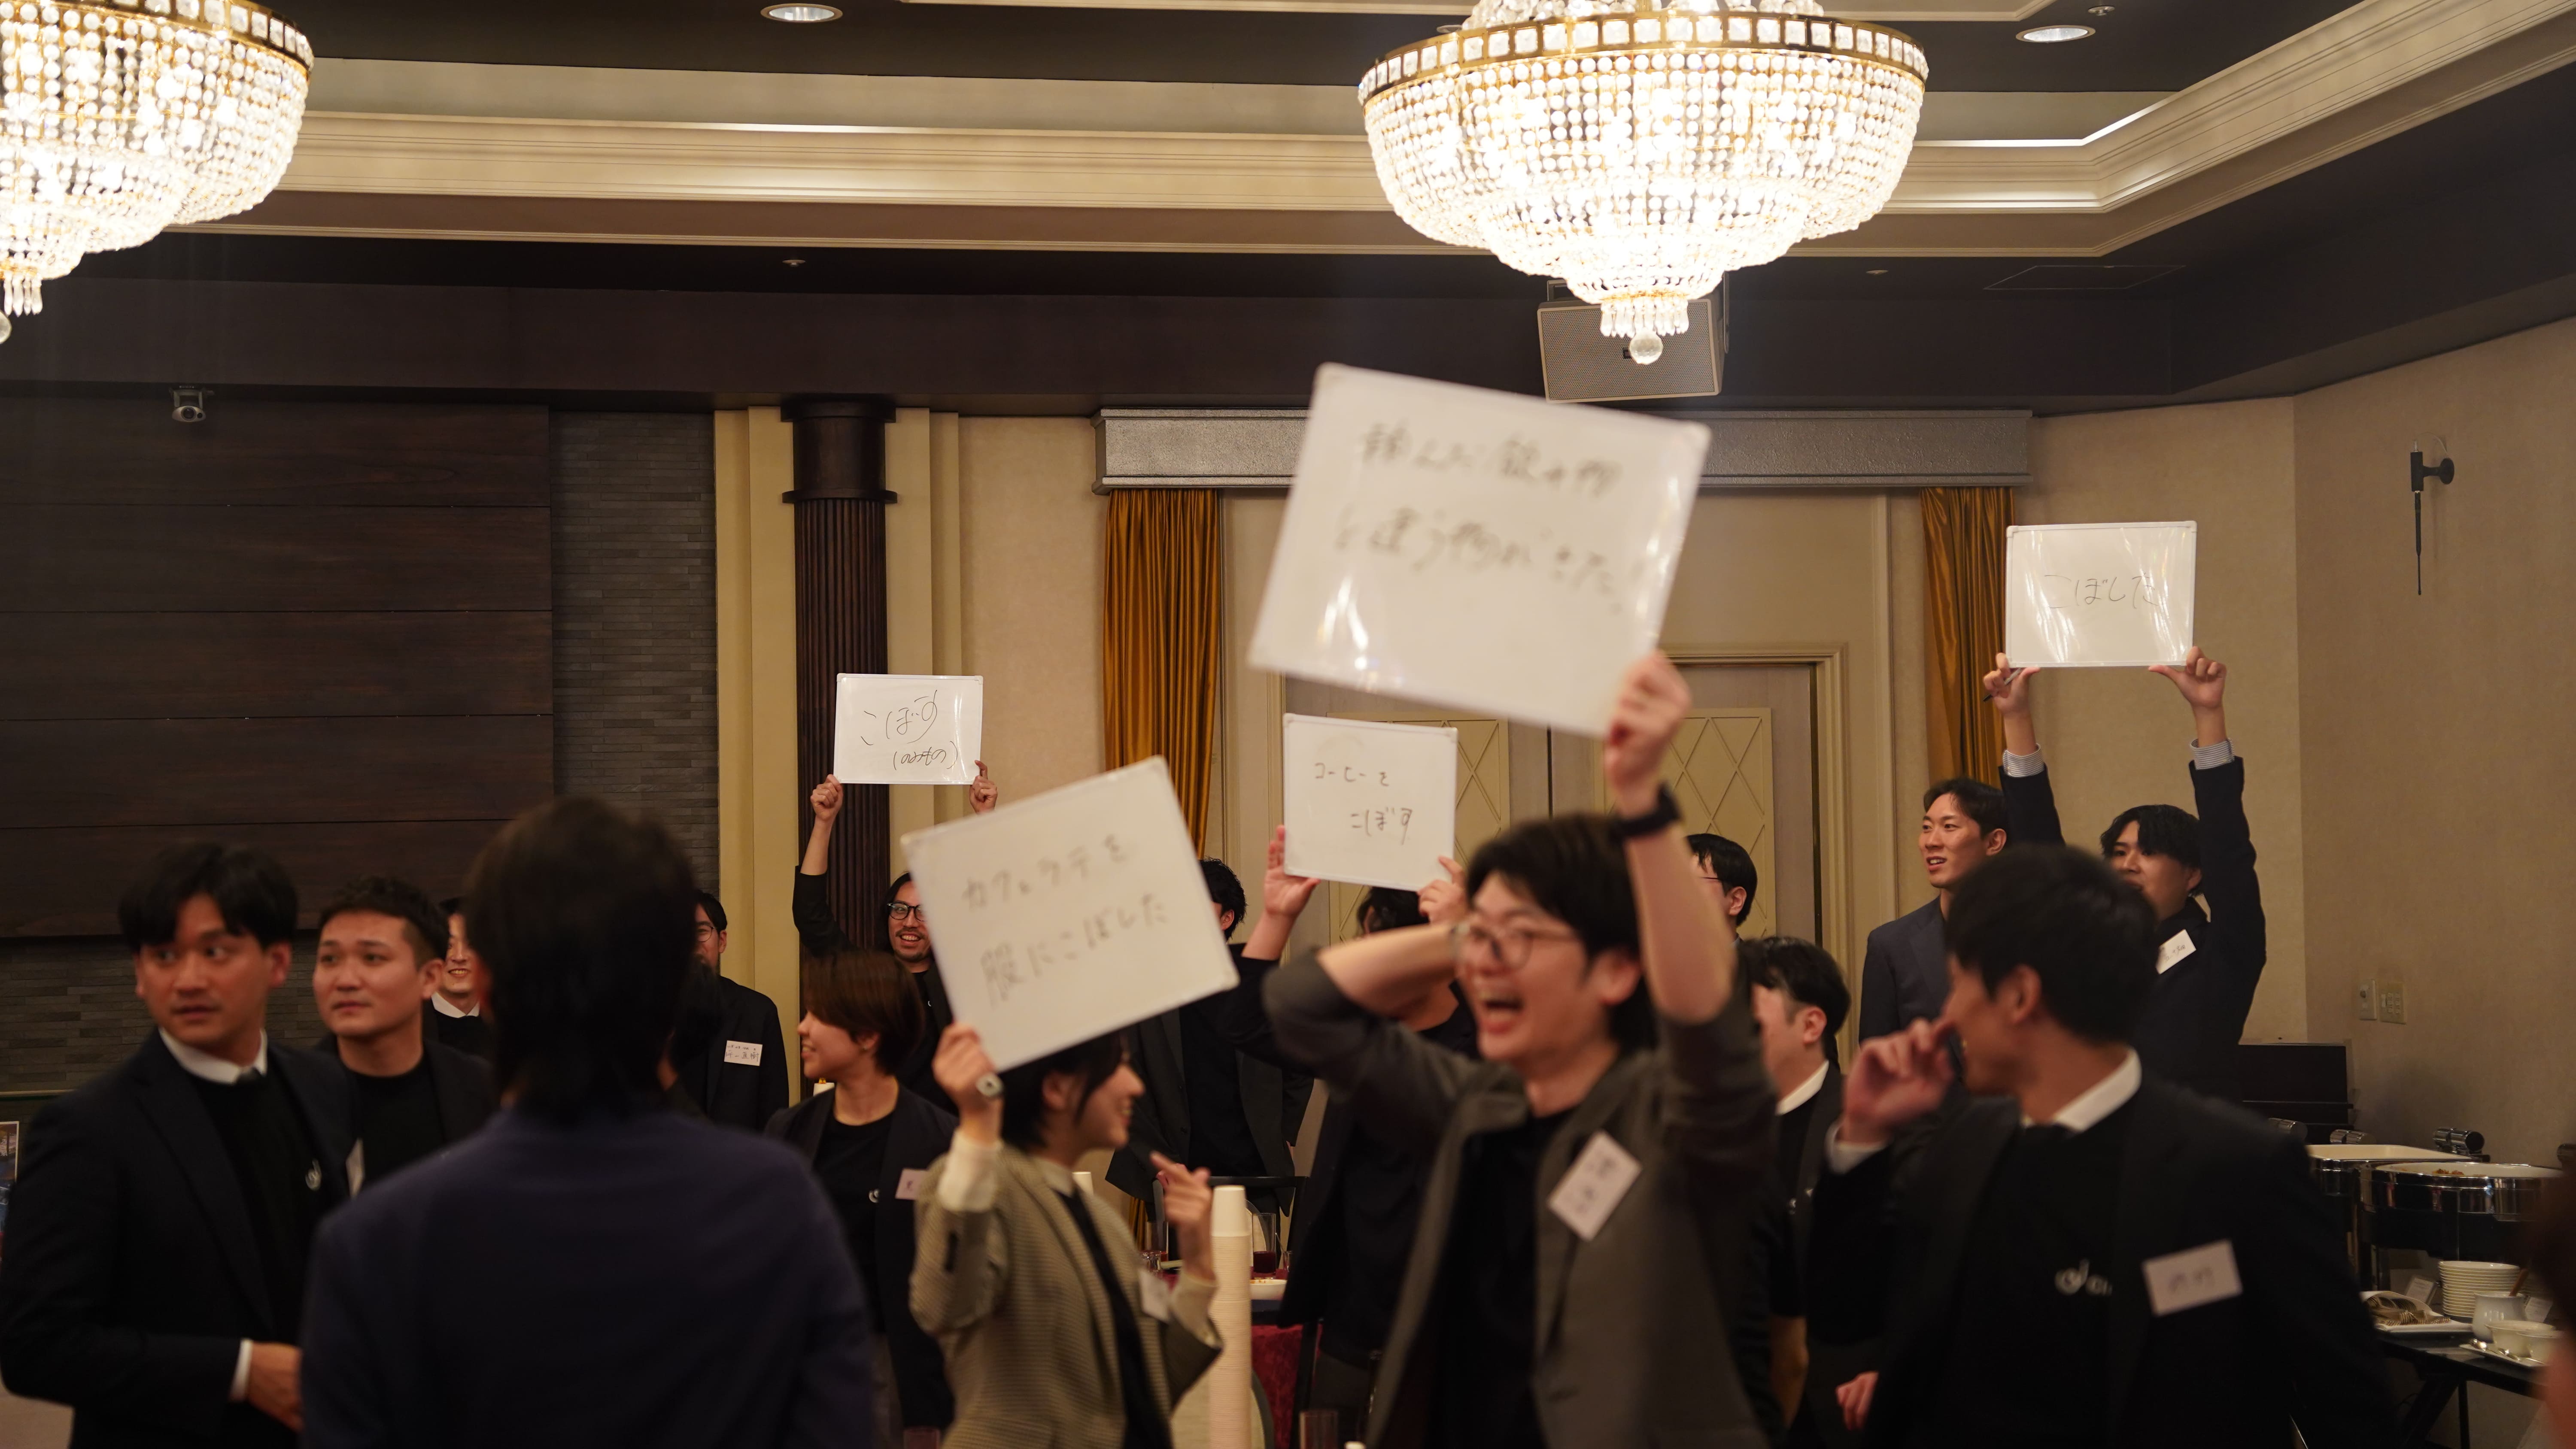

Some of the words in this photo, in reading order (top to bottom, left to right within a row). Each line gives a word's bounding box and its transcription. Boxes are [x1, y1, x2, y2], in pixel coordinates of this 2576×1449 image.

[2044, 573, 2159, 609] こぼした
[860, 690, 937, 746] こぼす
[1350, 806, 1413, 846] こぼす
